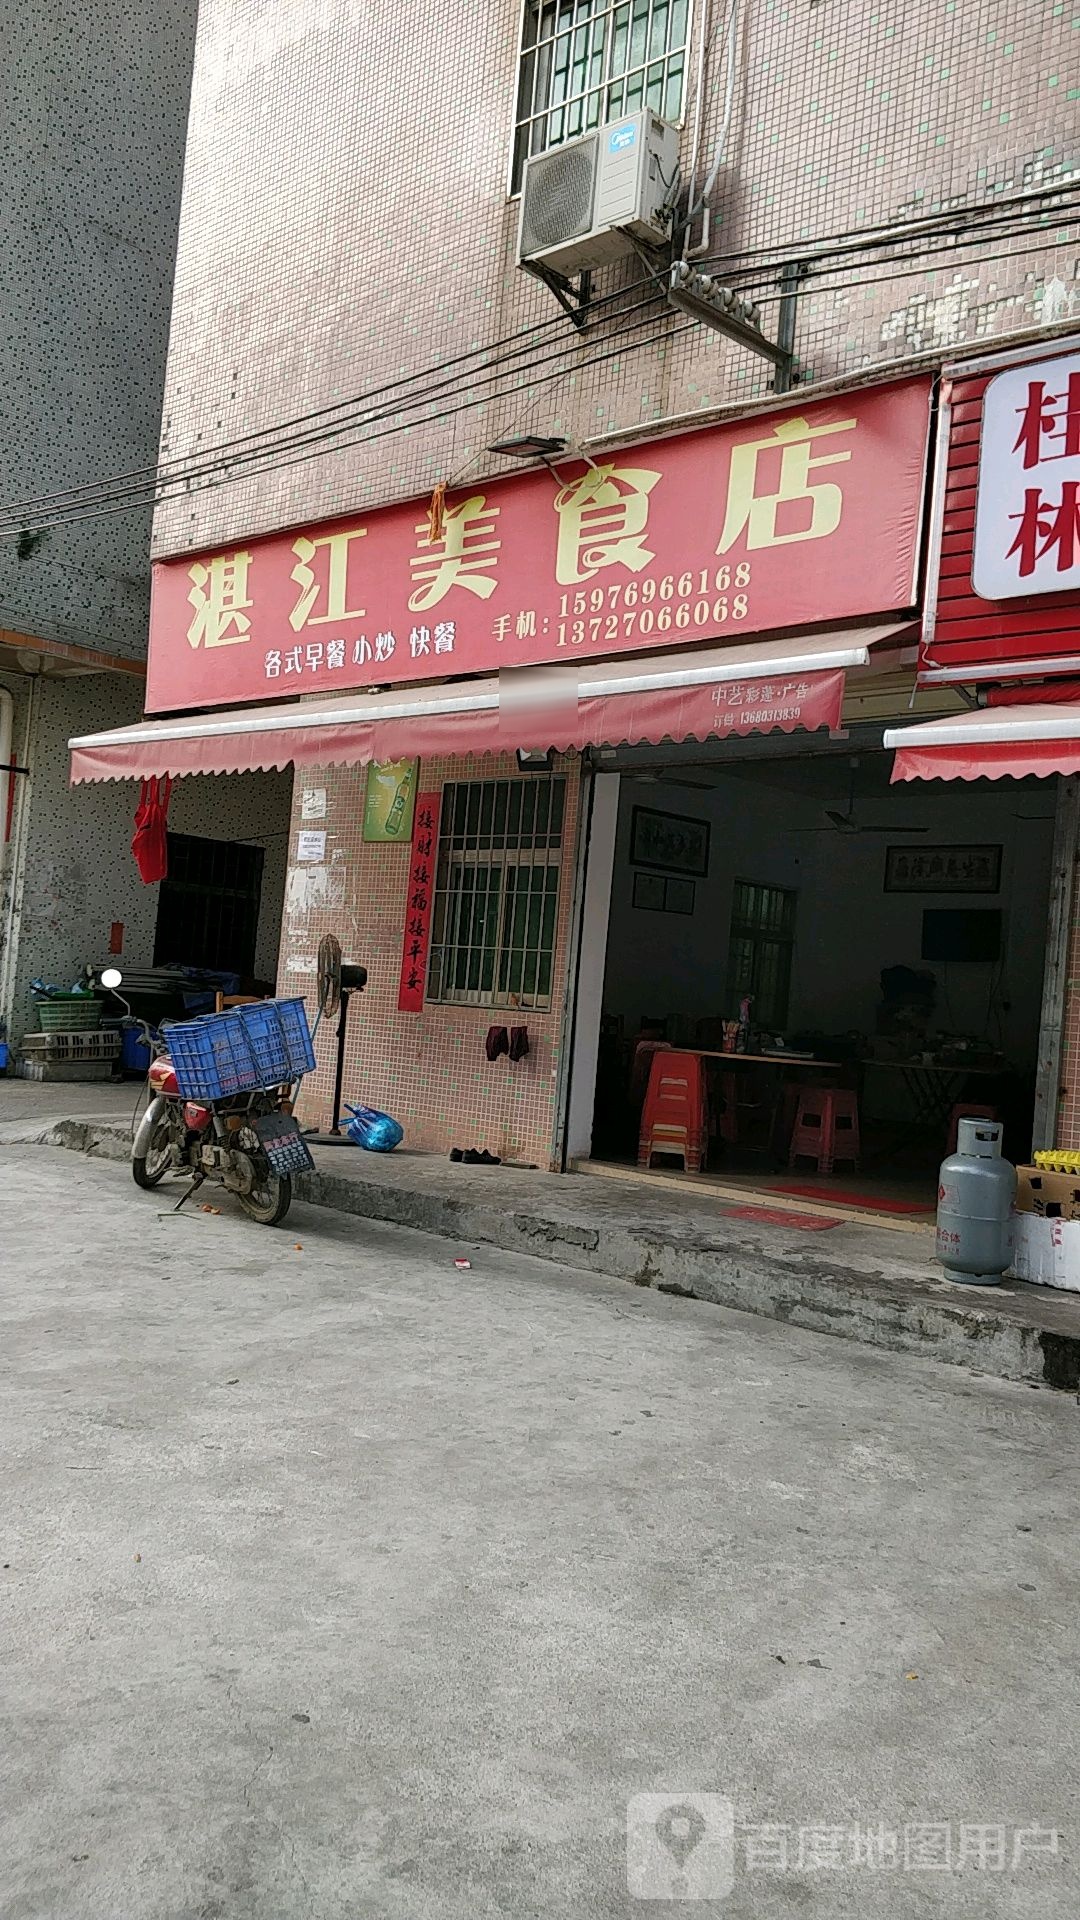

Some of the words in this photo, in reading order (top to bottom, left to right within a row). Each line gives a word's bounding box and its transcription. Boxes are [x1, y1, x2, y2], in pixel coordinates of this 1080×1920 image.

[187, 416, 858, 650] 湛江美食店
[557, 562, 752, 618] 15976966168
[555, 593, 750, 647] 13727066068
[263, 637, 346, 680] 各式早餐
[352, 631, 396, 665] 小炒
[409, 620, 457, 657] 快餐
